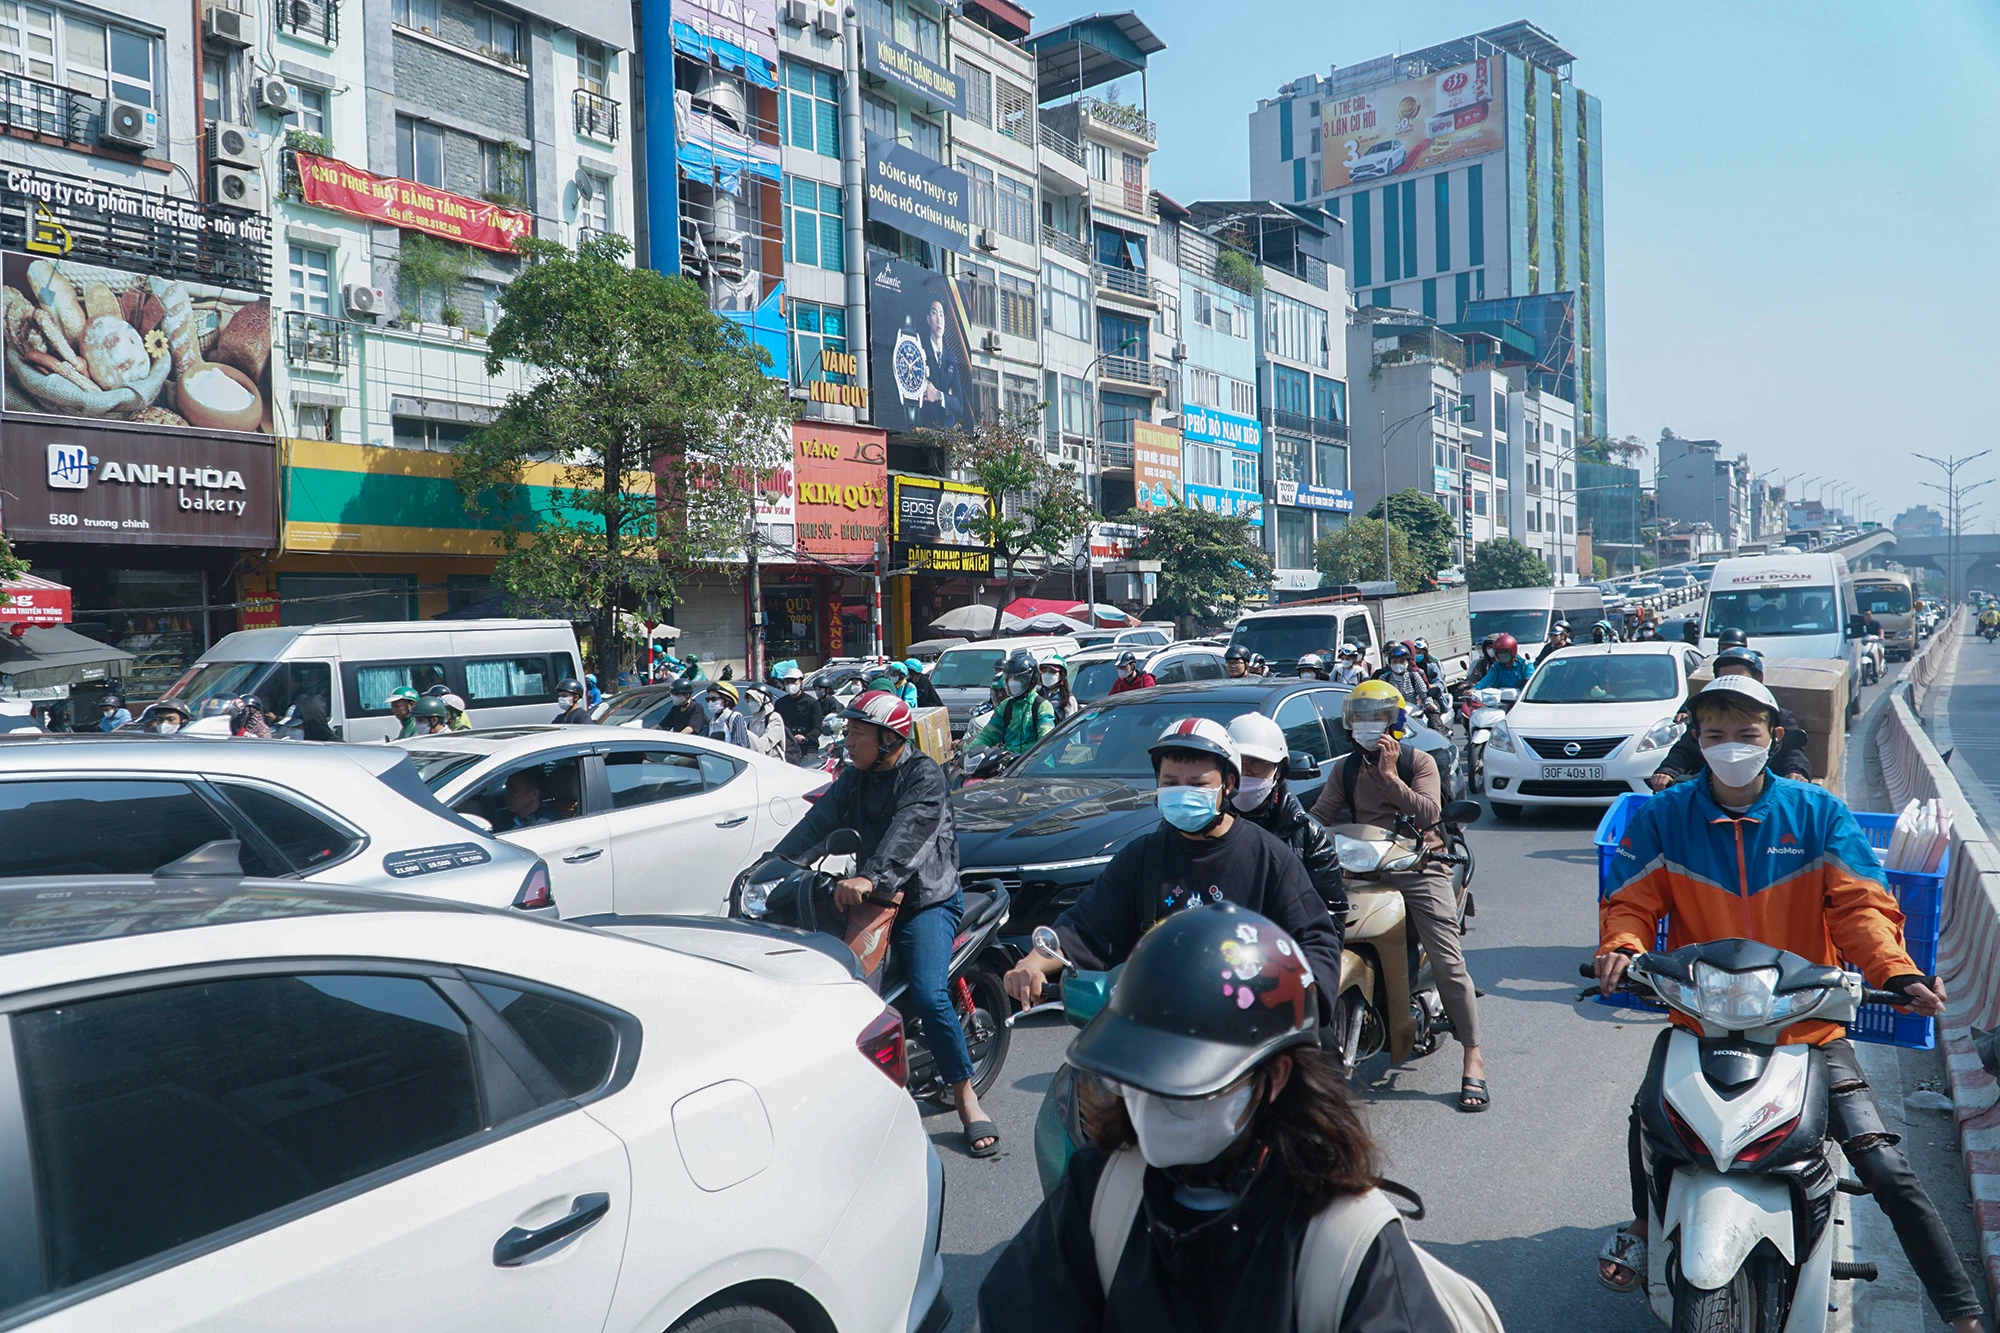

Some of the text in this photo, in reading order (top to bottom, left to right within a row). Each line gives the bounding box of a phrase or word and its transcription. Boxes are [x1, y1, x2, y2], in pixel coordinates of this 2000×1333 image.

[878, 41, 956, 100] KÍNH MẮT ĐĂNG QUANG
[1323, 121, 1329, 138] 3
[1342, 139, 1360, 168] 3
[7, 170, 51, 203] Công
[55, 182, 72, 206] ty
[74, 179, 95, 206] cổ
[97, 187, 137, 214] phần
[311, 164, 338, 185] CHO
[340, 171, 370, 195] THUÊ
[879, 160, 959, 207] ĐỒNG HỒ THỤY SỸ
[869, 183, 968, 237] ĐỒNG HỒ CHÍNH HÃNG
[875, 271, 902, 288] Atlantic
[821, 346, 858, 376] VÀNG
[810, 380, 839, 404] KIM
[1187, 409, 1260, 446] PHỞ BÒ NAM BÉO
[799, 437, 840, 460] VÀNG
[98, 461, 247, 491] ANH HÒA
[178, 488, 247, 517] bakery
[798, 482, 842, 506] KIM
[901, 500, 934, 516] epos
[49, 513, 150, 530] 580 truong chinh
[908, 544, 990, 572] ĐĂNG QUANG WATCH
[1732, 571, 1812, 583] BÍCH ĐOÀN
[829, 602, 842, 650] VÀNG
[1544, 767, 1601, 779] 30F-409.18
[1766, 846, 1805, 855] AhaMove
[1803, 1159, 1826, 1178] HONDA
